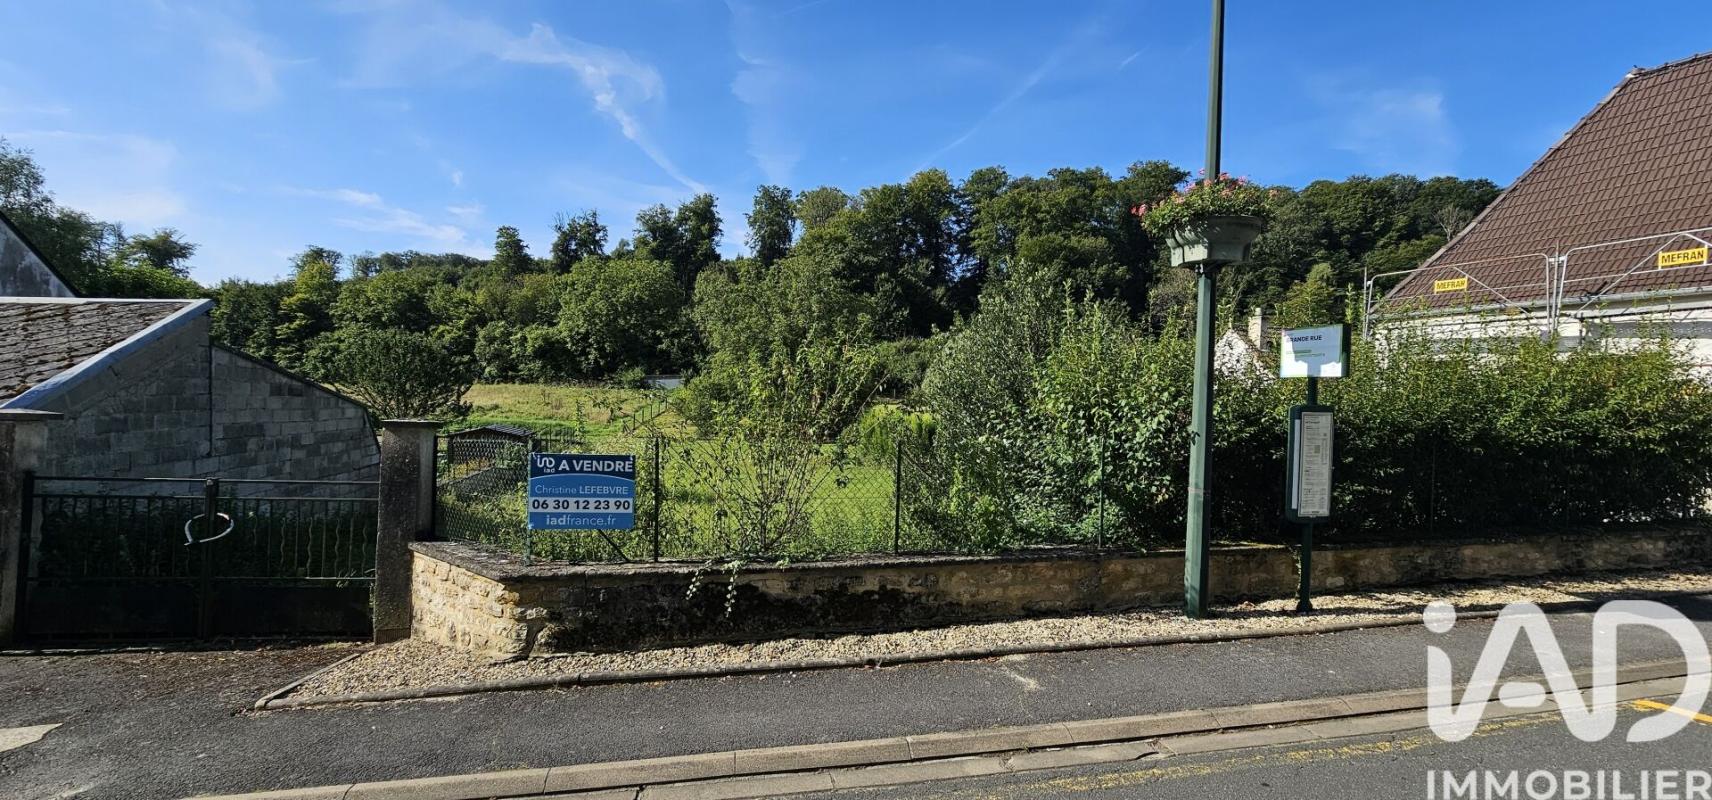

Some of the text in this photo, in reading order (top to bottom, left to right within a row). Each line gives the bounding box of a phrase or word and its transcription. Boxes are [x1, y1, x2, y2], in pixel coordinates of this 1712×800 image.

[1661, 250, 1704, 264] MEFRAN
[1436, 280, 1466, 290] MEFRAN
[558, 459, 634, 473] A VENDRE
[534, 484, 629, 495] Christine LEFEBVRE
[532, 499, 631, 511] 06 30 12 23 90
[546, 514, 616, 526] iadfrance.fr
